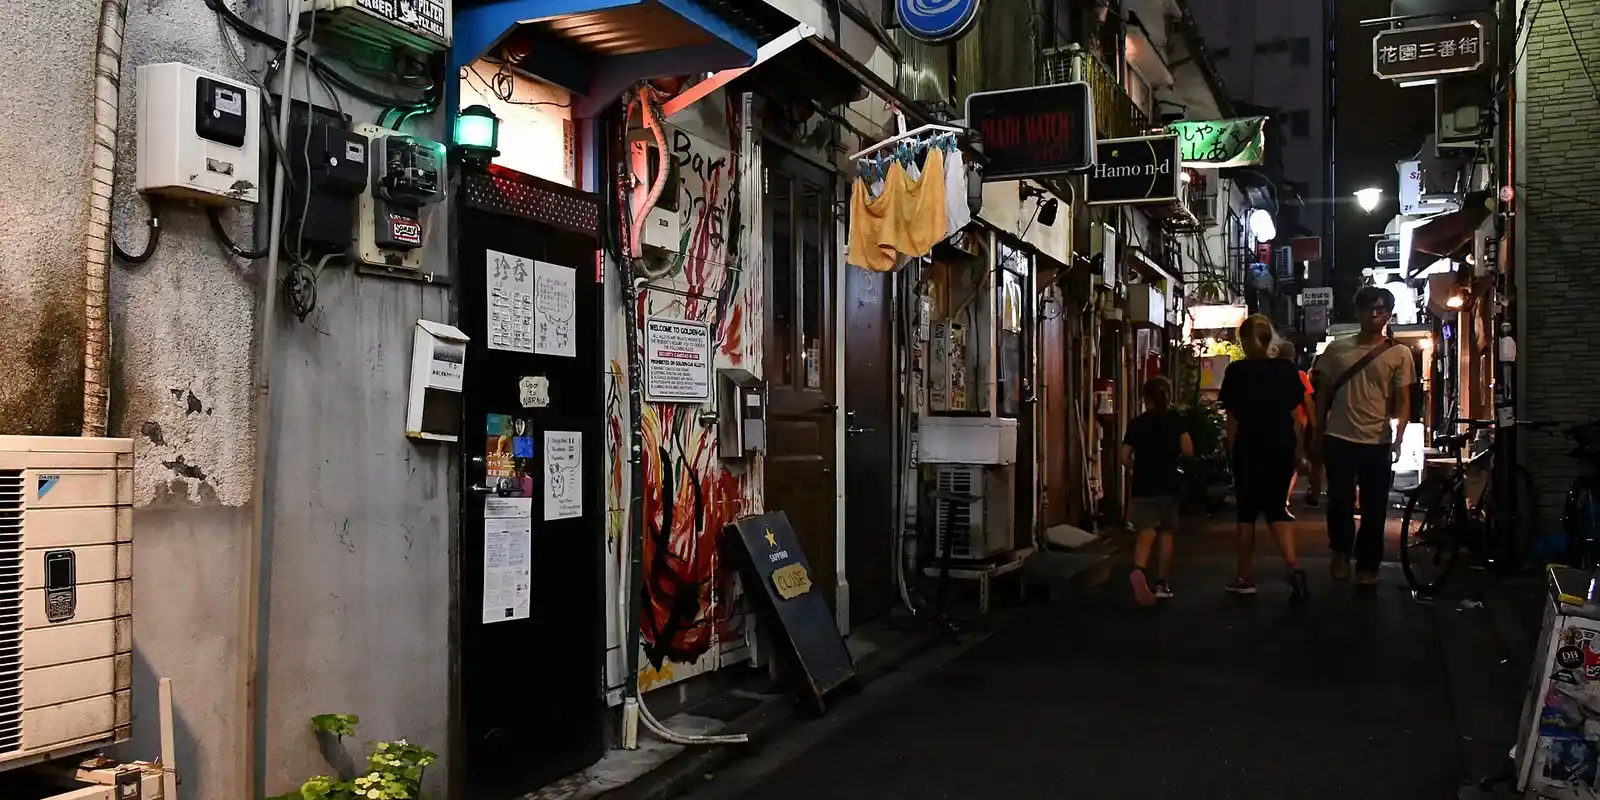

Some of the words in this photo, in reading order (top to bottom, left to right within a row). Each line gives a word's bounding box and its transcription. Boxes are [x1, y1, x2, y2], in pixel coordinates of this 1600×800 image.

[1379, 38, 1479, 64] 花園三番街
[674, 129, 726, 184] Bar
[1094, 163, 1141, 178] Hamo
[650, 324, 672, 333] WELCOME
[778, 571, 806, 590] CLOSE
